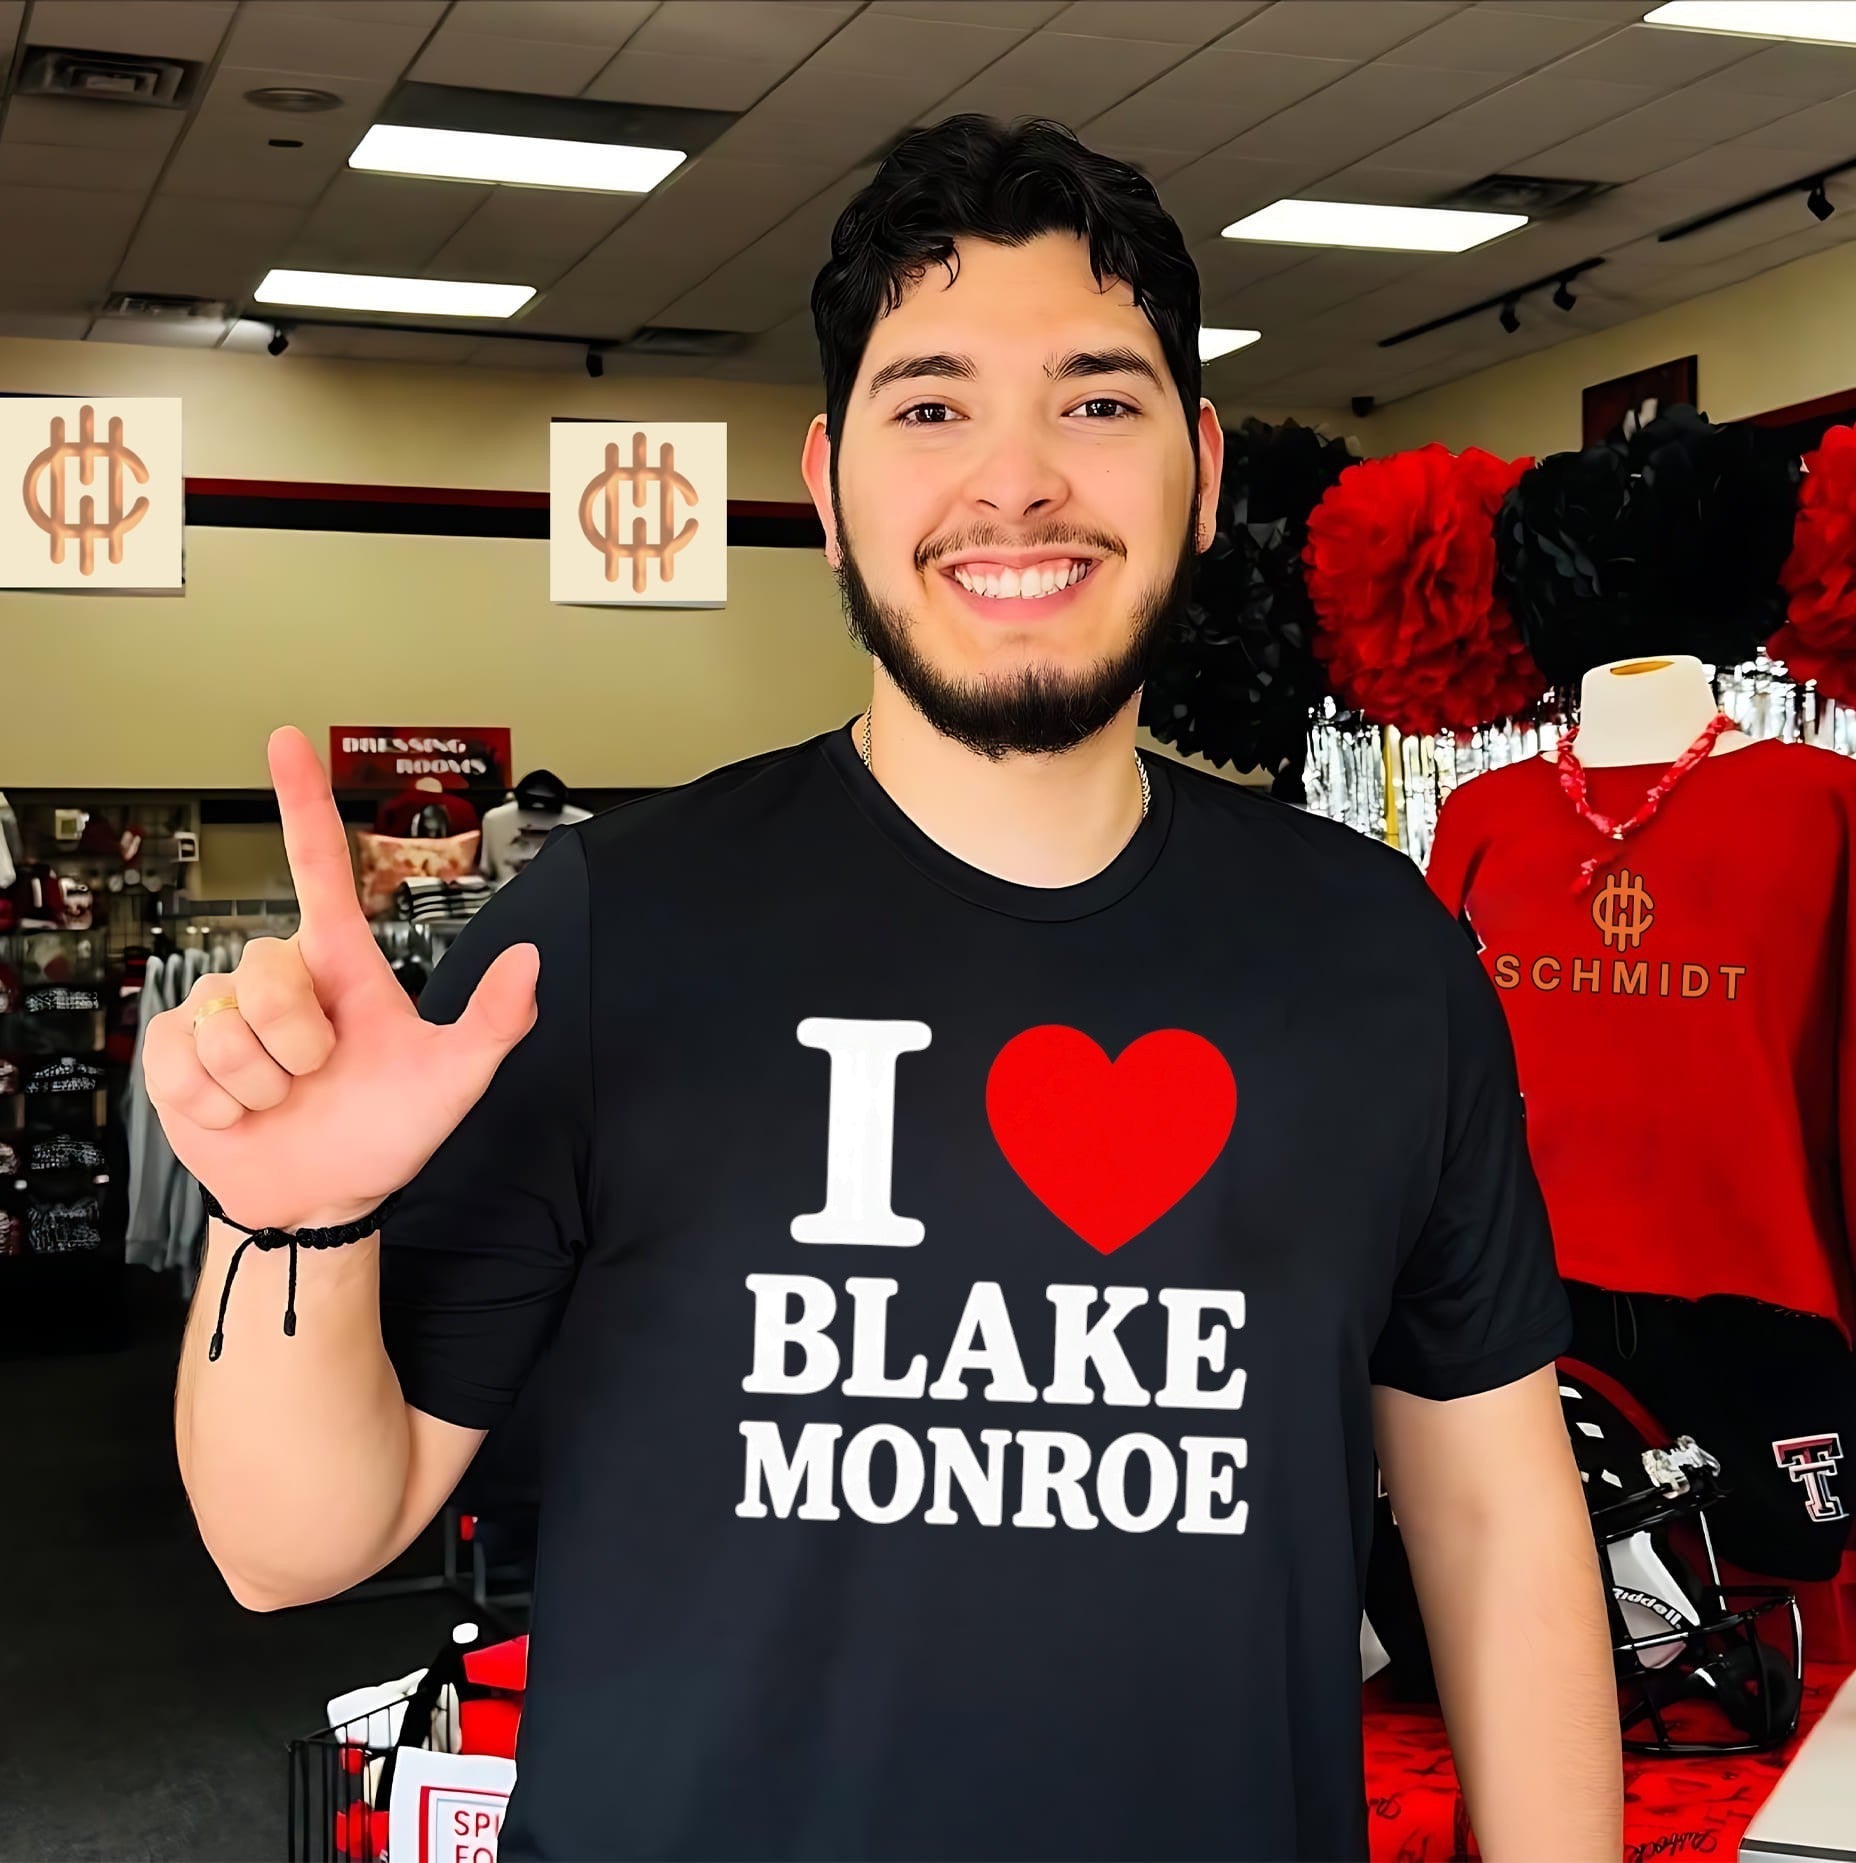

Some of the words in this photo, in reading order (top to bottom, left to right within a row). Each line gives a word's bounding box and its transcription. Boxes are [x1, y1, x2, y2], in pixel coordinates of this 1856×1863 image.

[396, 758, 487, 775] ROOMS
[1494, 954, 1747, 1000] SCHMIDT
[790, 1017, 932, 1247] I
[742, 1273, 1247, 1409] BLAKE
[735, 1420, 1248, 1534] MONROE
